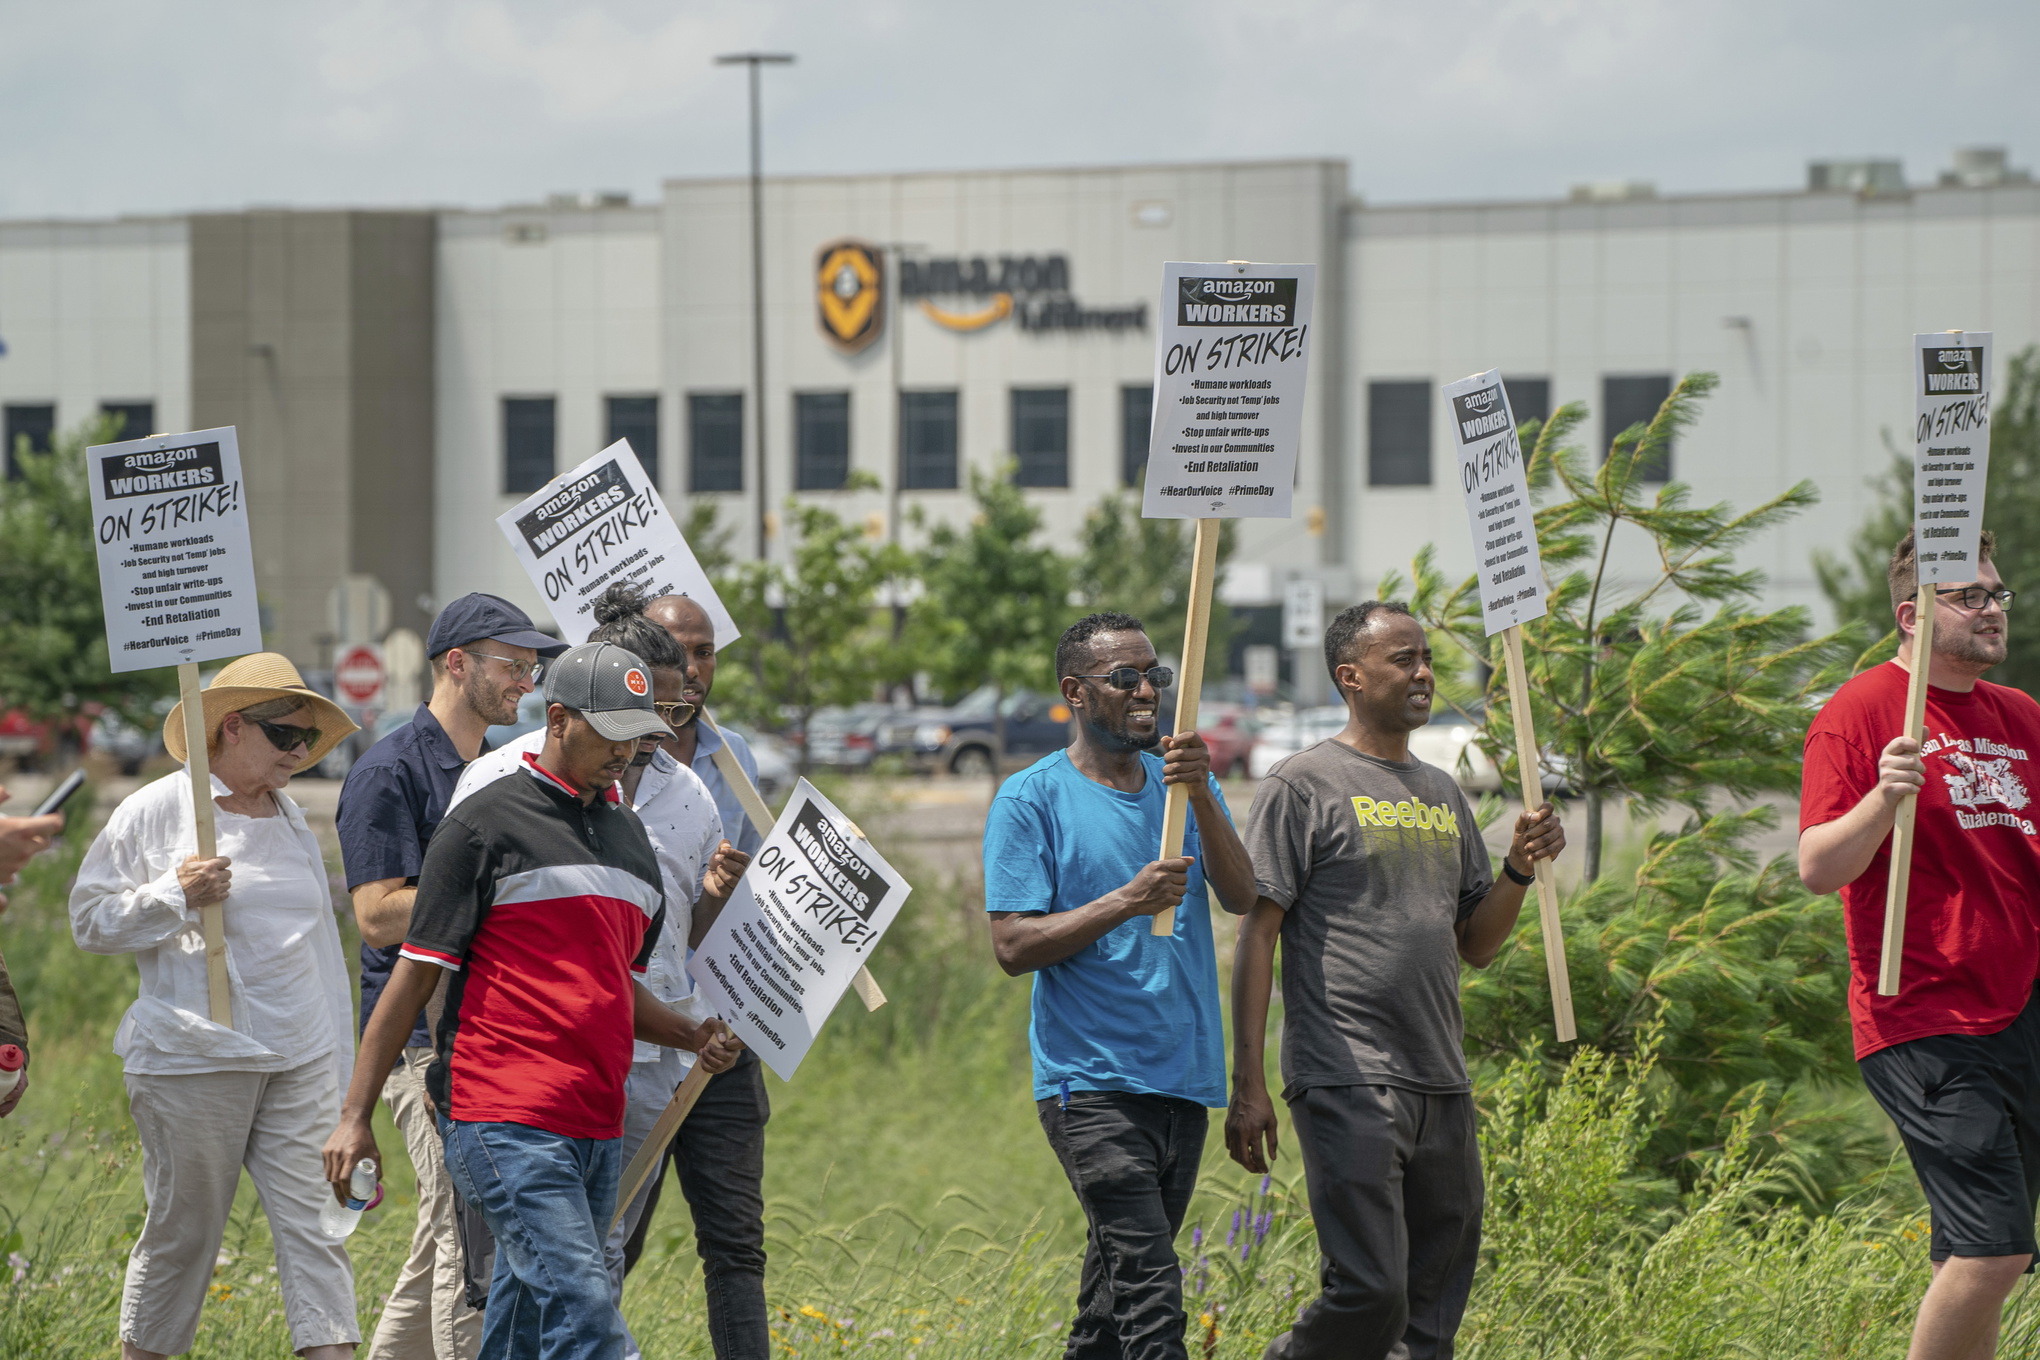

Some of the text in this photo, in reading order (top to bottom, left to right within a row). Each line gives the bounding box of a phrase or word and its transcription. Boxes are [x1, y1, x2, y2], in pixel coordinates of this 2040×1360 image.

[1203, 281, 1275, 294] amazon
[1186, 304, 1286, 322] WORKERS
[1165, 324, 1307, 375] ON STRIKE!
[1229, 379, 1271, 389] workloads
[1195, 395, 1226, 405] Security
[1226, 396, 1239, 404] not
[1263, 395, 1279, 405] jobs
[1196, 411, 1259, 421] and high turnover
[1205, 426, 1230, 437] unfair
[1230, 427, 1269, 437] write-ups
[125, 447, 198, 468] amazon
[1200, 443, 1209, 453] in
[1209, 445, 1223, 453] our
[1224, 443, 1274, 453] Communities
[1206, 460, 1258, 472] Retaliation
[110, 466, 214, 495] WORKERS
[1160, 485, 1274, 496] #HearOurVoice #PrimeDay
[536, 474, 600, 521] amazon
[100, 480, 238, 544] ON STRIKE!
[532, 484, 625, 552] WORKERS
[170, 534, 213, 547] workloads
[544, 487, 658, 601] ON STRIKE!
[137, 555, 170, 566] Security
[171, 553, 184, 562] not
[209, 547, 226, 557] jobs
[608, 548, 648, 576] workloads
[647, 554, 664, 568] jobs
[142, 564, 208, 579] and high turnover
[155, 582, 181, 593] unfair
[182, 576, 223, 589] write-ups
[154, 599, 163, 608] in
[164, 598, 178, 606] our
[179, 590, 232, 604] Communities
[165, 608, 220, 624] Retaliation
[123, 627, 241, 650] #HearOurVoice #PrimeDay
[1973, 737, 2029, 760] Mission
[1350, 795, 1461, 838] Reebok
[816, 818, 871, 880] amazon
[797, 822, 869, 912] WORKERS
[759, 847, 878, 953] ON STRIKE!
[756, 919, 803, 972] and high turnover
[763, 904, 784, 933] Security
[782, 930, 793, 944] not
[809, 958, 825, 976] jobs
[790, 919, 825, 956] workloads
[754, 939, 773, 963] unfair
[771, 960, 805, 995] write-ups
[745, 949, 753, 960] in
[751, 958, 762, 971] our
[760, 968, 802, 1013] Communities
[705, 956, 786, 1050] #HearOurVoice #PrimeDay
[741, 969, 783, 1017] Retaliation
